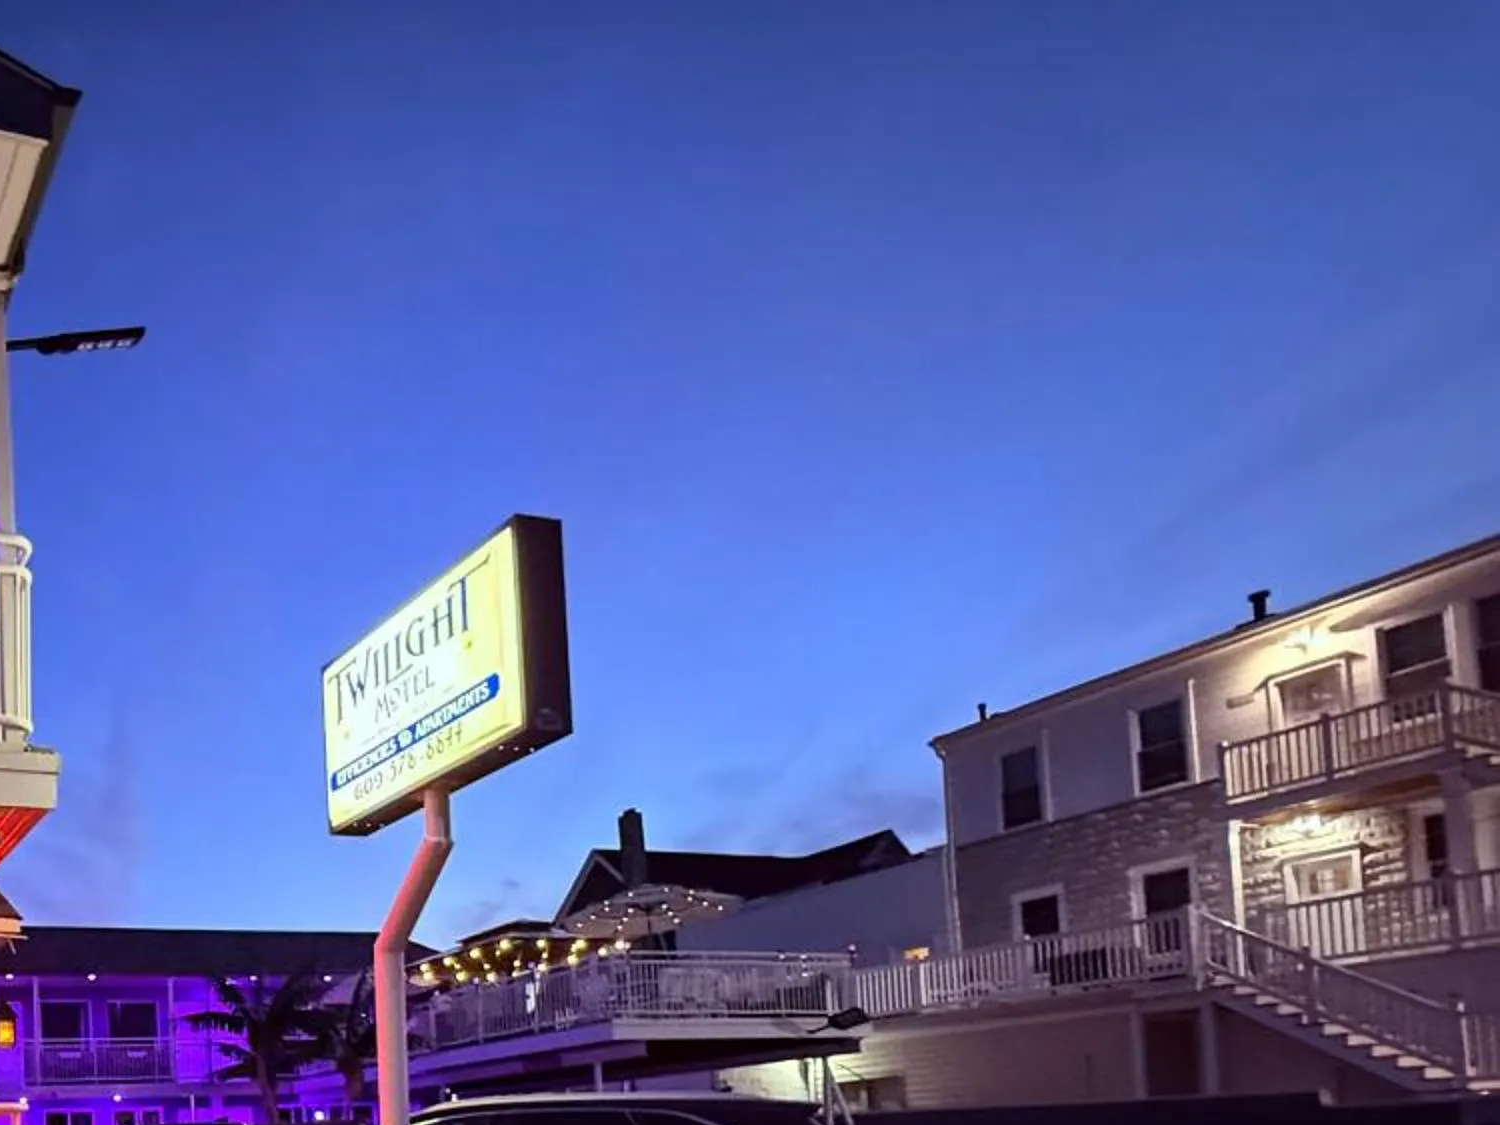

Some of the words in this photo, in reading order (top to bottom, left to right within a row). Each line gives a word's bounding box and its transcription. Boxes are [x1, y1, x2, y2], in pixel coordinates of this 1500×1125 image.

[328, 553, 491, 725] TWILIGHT
[374, 665, 435, 723] MOTEL
[413, 684, 492, 740] APARTMENTS
